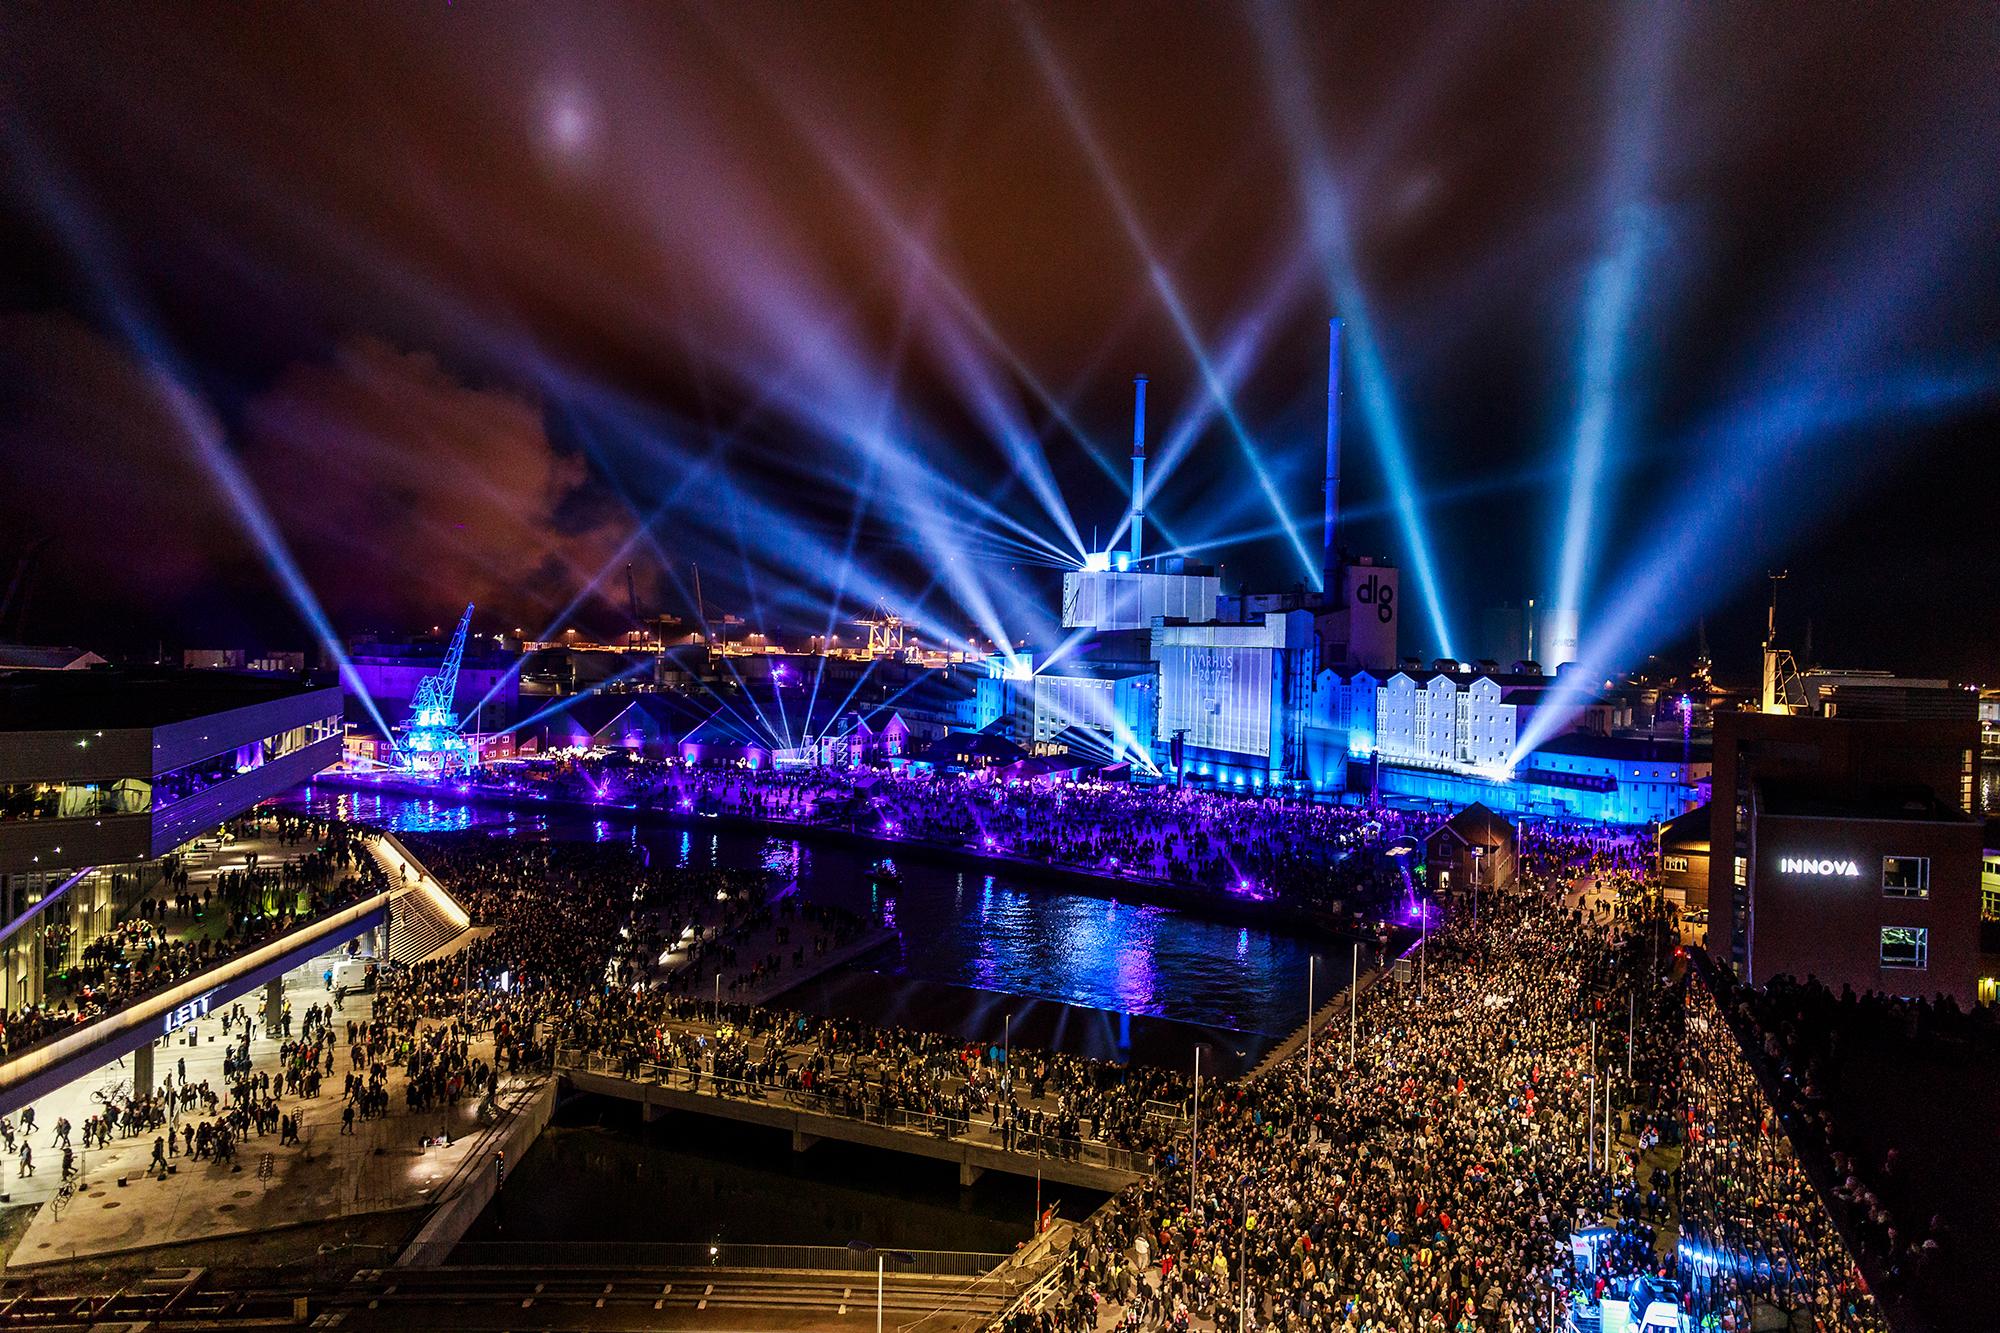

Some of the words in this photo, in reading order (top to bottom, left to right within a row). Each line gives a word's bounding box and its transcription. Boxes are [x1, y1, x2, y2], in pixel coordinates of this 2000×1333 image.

[1357, 574, 1393, 624] dlg
[1190, 654, 1233, 668] AARHUS
[1780, 858, 1860, 876] INNOVA
[164, 992, 214, 1031] LETT
